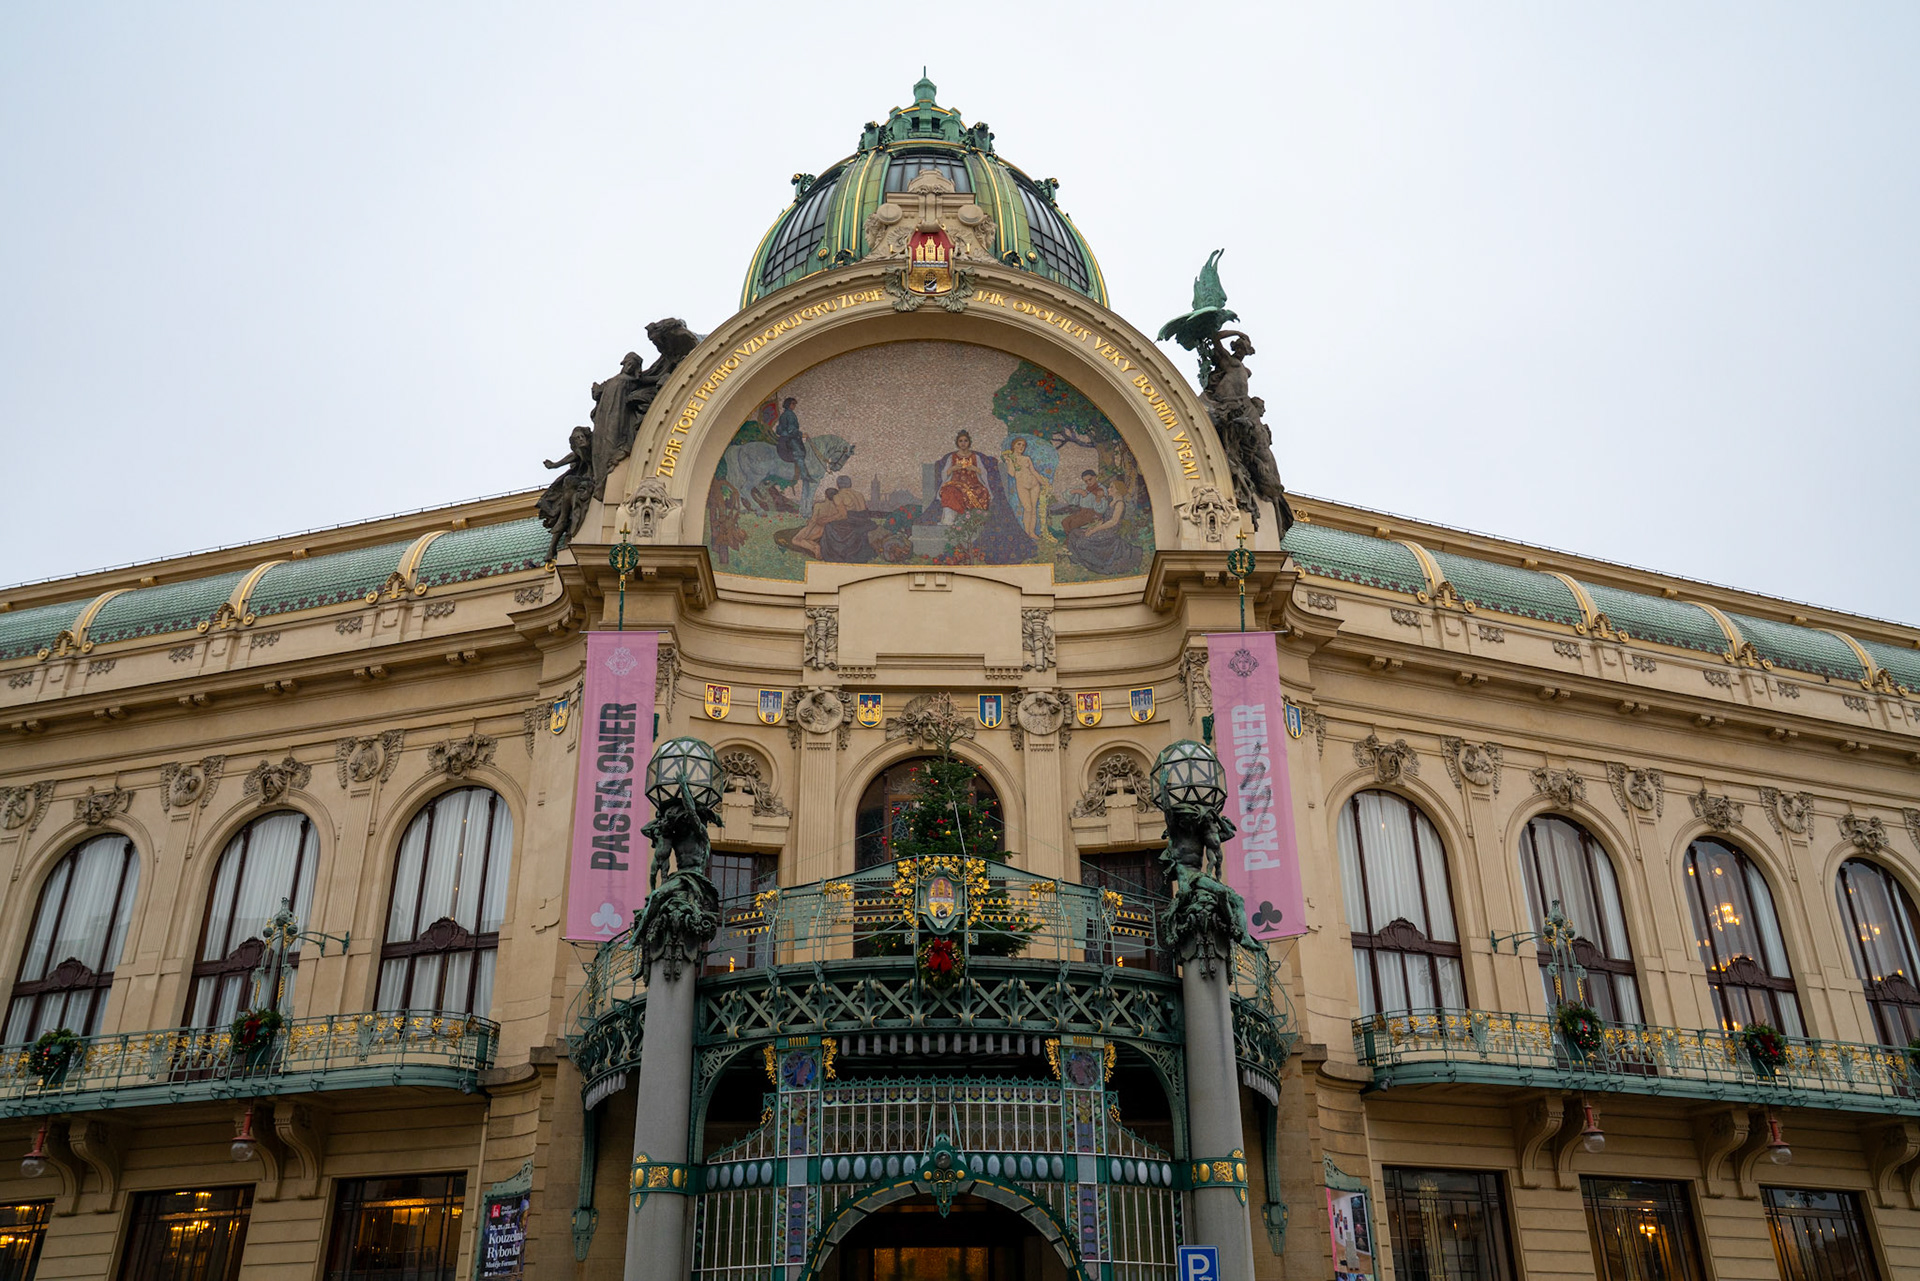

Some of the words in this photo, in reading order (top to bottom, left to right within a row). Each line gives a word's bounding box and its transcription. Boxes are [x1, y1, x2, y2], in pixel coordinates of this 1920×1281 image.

[973, 290, 1009, 308] JAK
[1012, 300, 1092, 342] ODOLALAS
[656, 437, 684, 479] ZDAR
[735, 313, 803, 357] VZDORUJ
[1188, 1254, 1210, 1281] P
